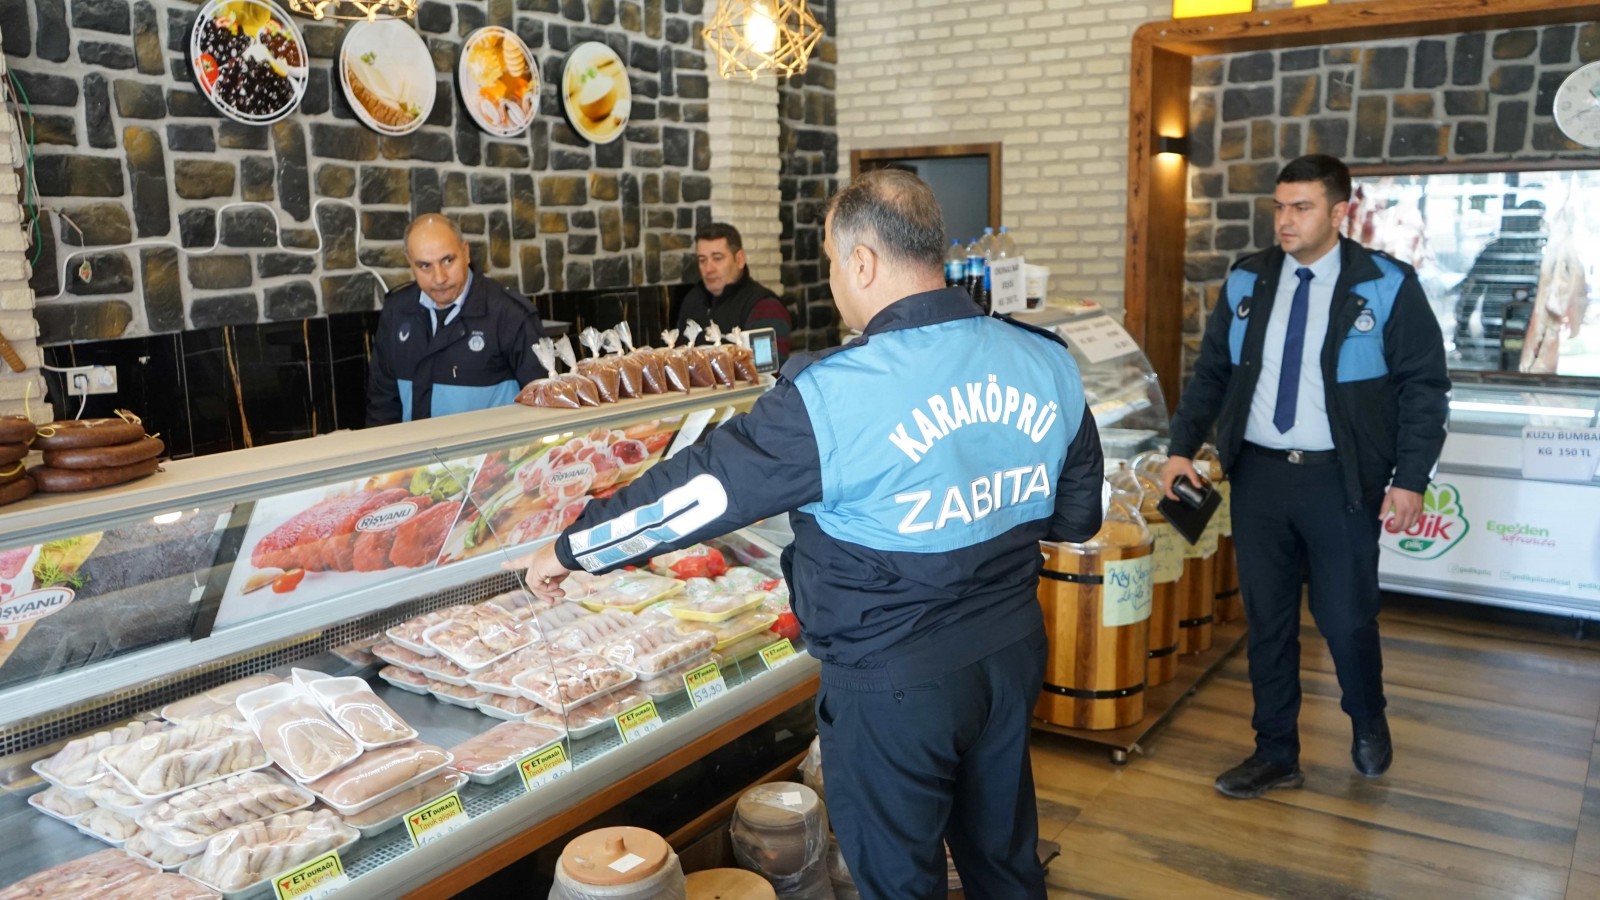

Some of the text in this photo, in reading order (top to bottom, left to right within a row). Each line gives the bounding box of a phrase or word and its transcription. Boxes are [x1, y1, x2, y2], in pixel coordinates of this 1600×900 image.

[888, 373, 1058, 464] KARAKÖPRÜ
[1526, 431, 1555, 440] KUZU
[1538, 447, 1592, 457] KG 150 TL
[895, 462, 1052, 533] ZABITA
[1385, 514, 1454, 540] edik
[1487, 520, 1549, 537] Ege'den
[626, 712, 635, 721] ET
[531, 757, 541, 768] ET
[420, 801, 455, 821] ET DURAĞI
[292, 861, 334, 885] ET DURAĞI
